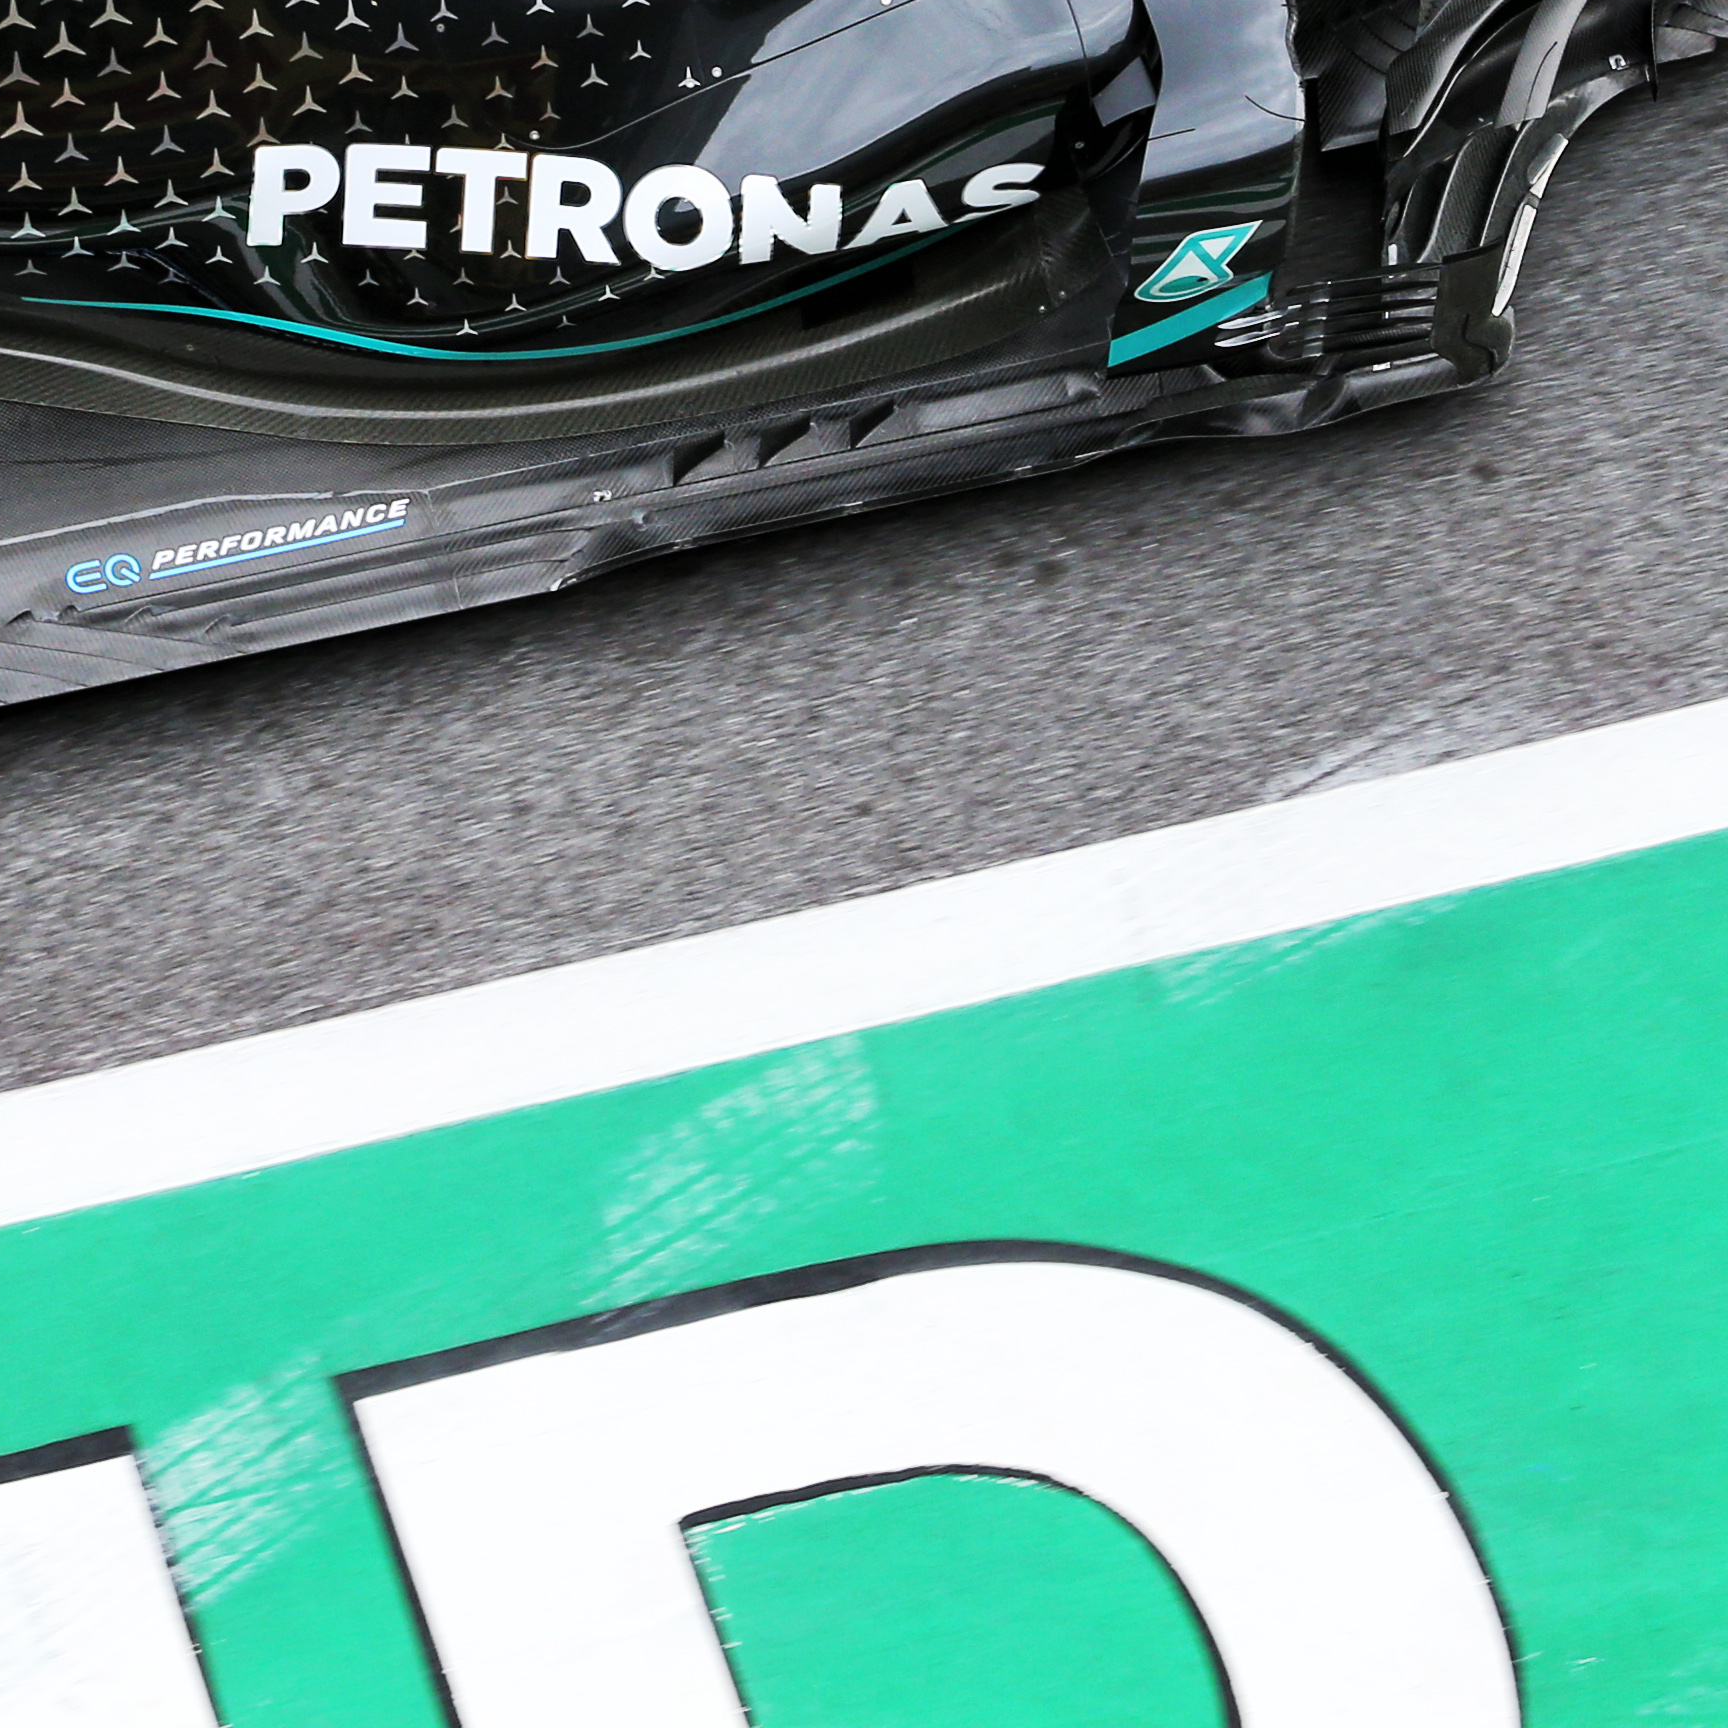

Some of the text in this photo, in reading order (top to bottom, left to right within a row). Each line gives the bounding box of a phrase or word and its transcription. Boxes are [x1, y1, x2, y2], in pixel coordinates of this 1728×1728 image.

[247, 143, 1049, 270] PETRONAS
[66, 498, 411, 594] EQ PERFORMANCE
